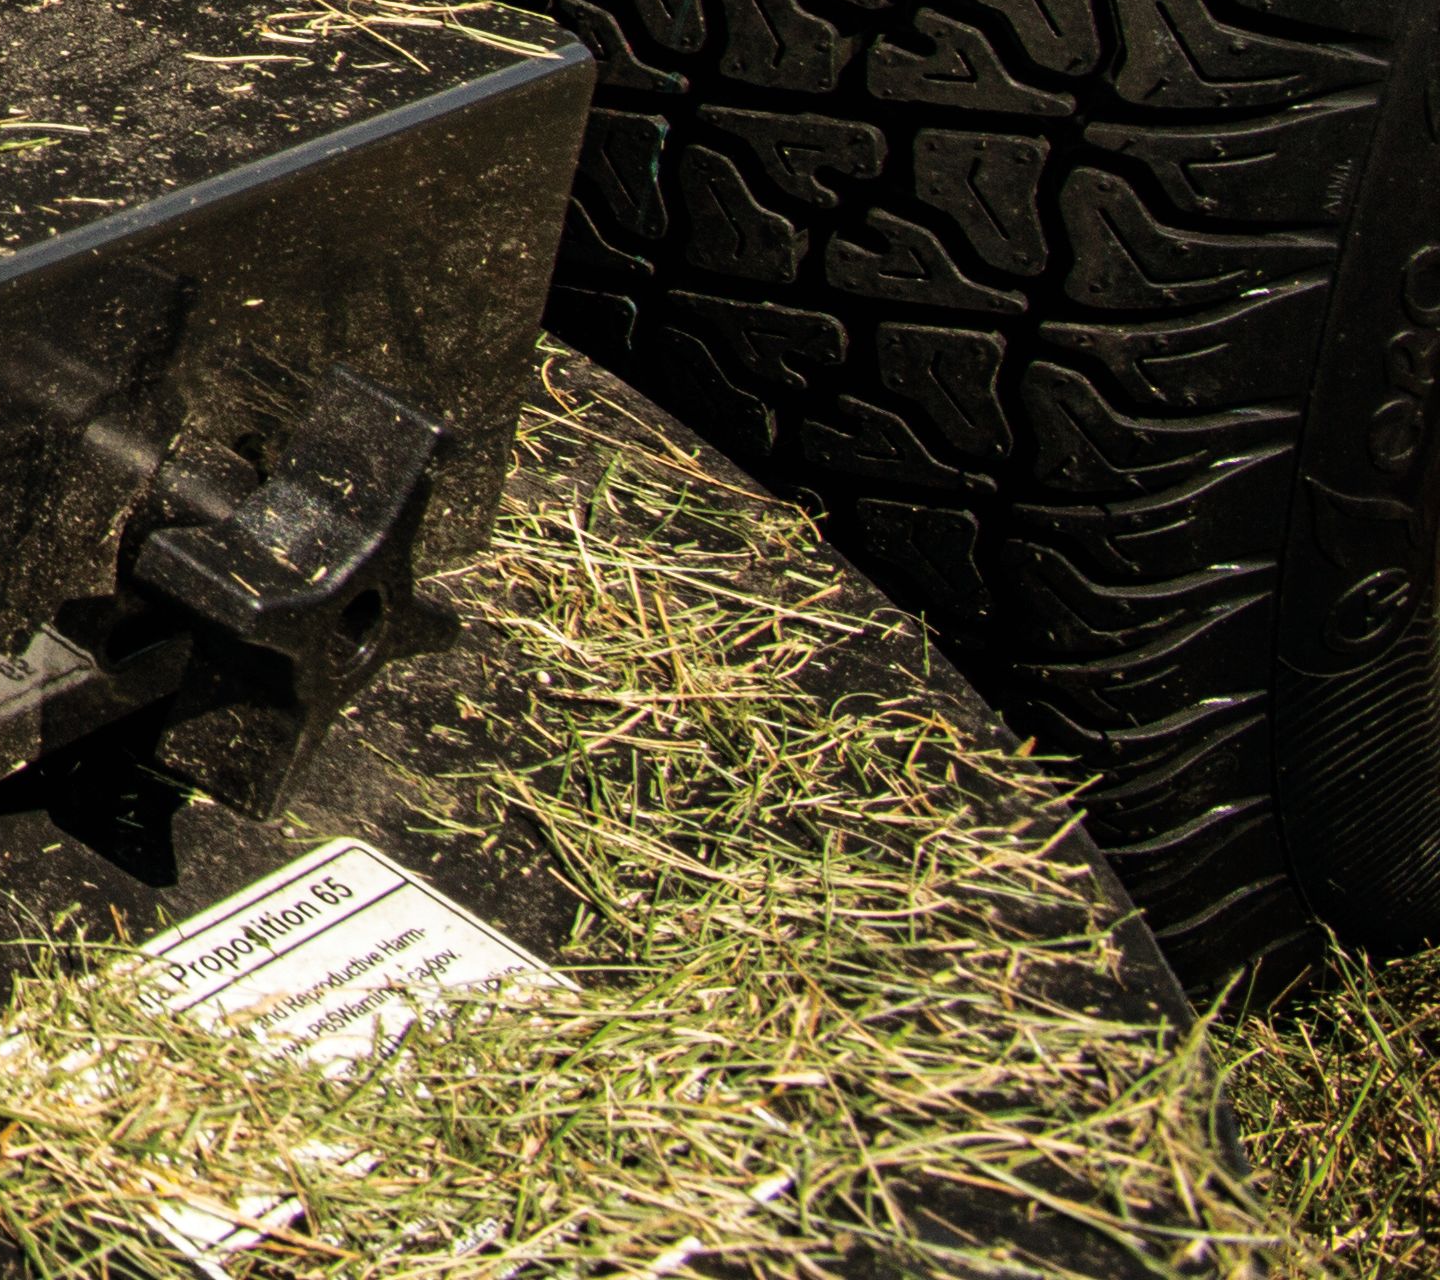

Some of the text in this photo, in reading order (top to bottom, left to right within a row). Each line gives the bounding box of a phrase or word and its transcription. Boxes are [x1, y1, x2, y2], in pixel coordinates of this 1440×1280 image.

[312, 876, 354, 906] 65
[255, 1002, 289, 1029] and
[283, 950, 385, 1015] Reproductive
